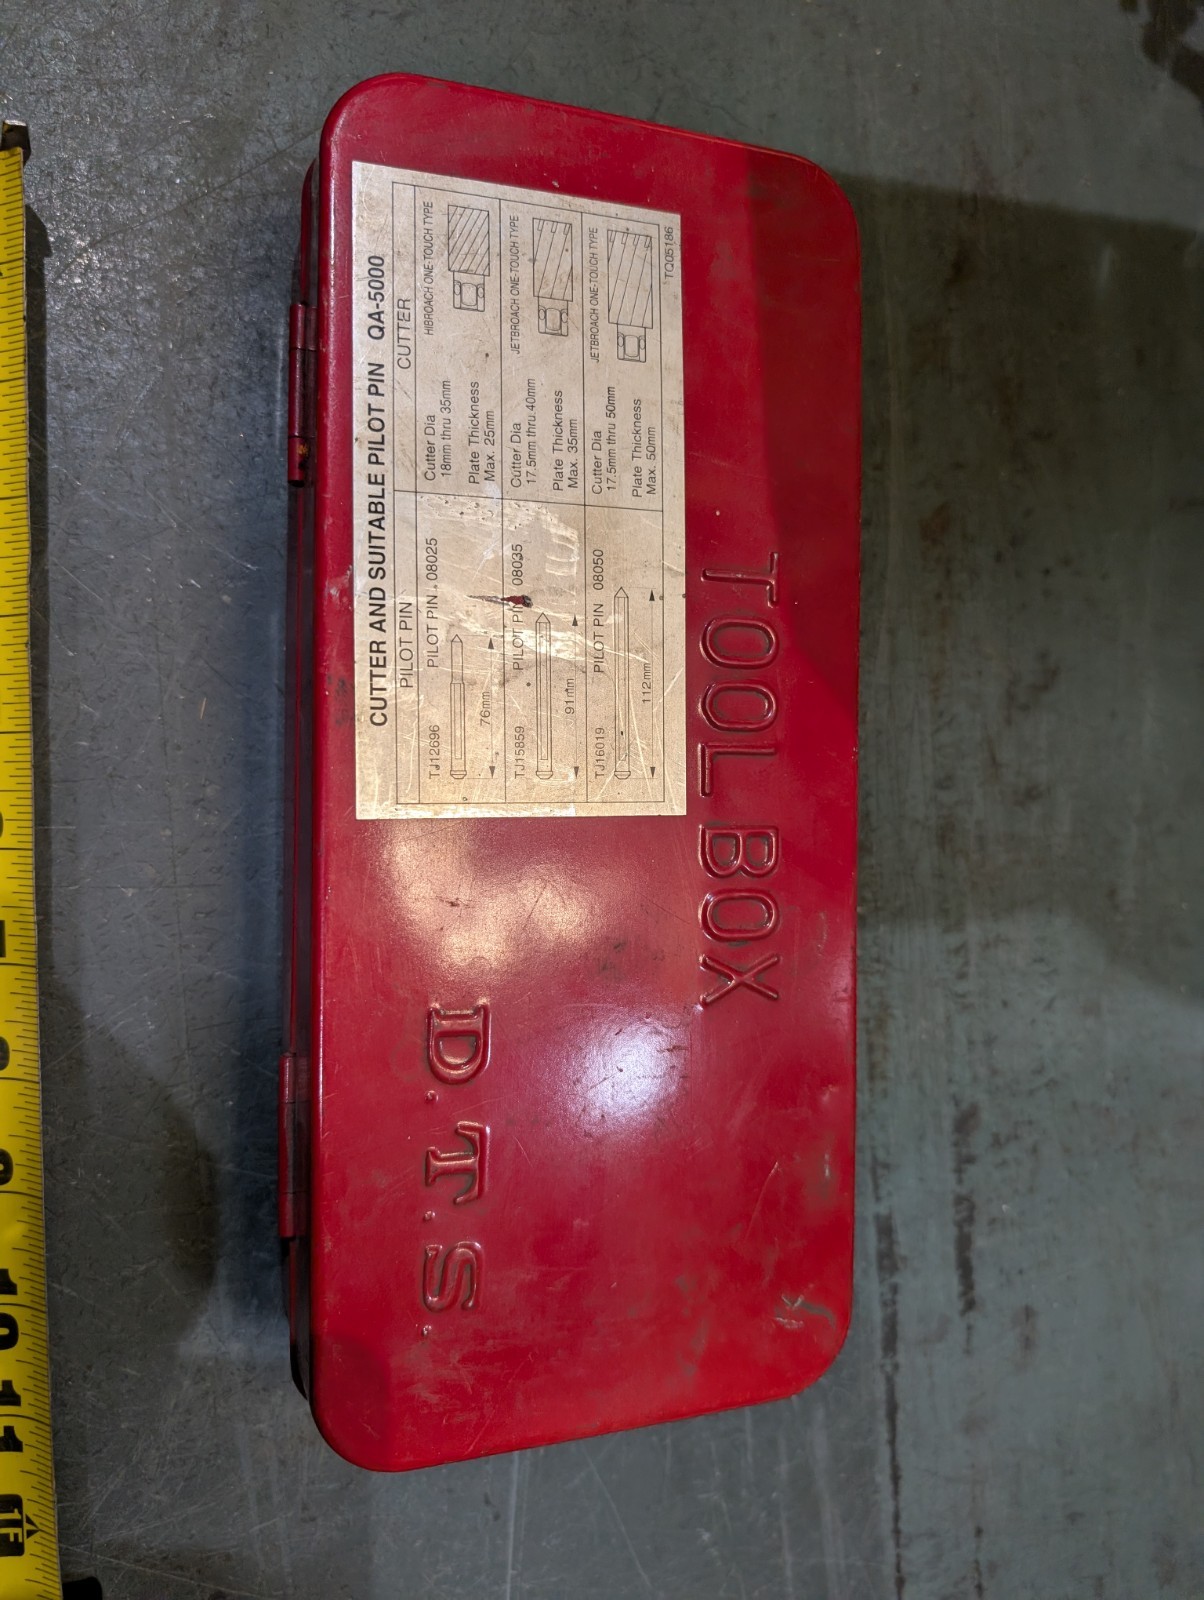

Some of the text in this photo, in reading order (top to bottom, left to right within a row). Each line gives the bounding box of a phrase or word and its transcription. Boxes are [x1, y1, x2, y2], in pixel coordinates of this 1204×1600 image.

[423, 201, 434, 335] HIBROACH ONE-TOUCH TYPE
[509, 215, 520, 354] JETBROACH ONE-TOUCH TYPE
[664, 226, 675, 279] TQ05186
[589, 227, 600, 363] JETBROACH ONE-TOUCH TYPE
[397, 298, 411, 370] CUTTER
[424, 415, 436, 481] Cutter Dia
[441, 380, 451, 477] 18mm thru 35mm
[468, 381, 480, 484] Plate Thickness
[484, 410, 495, 482] Max. 25mm
[511, 423, 522, 488] Cutter Dia
[526, 378, 537, 484] 17.5mm thru 40mm
[552, 390, 564, 491] Plate Thickness
[568, 419, 578, 488] Max. 35mm
[592, 431, 603, 495] Cutter Dia
[605, 386, 617, 491] 17.5mm thru 50mm
[631, 399, 643, 498] Plate Thickness
[646, 426, 656, 495] Max. 50mm
[368, 255, 387, 726] CUTTER AND SUITABLE PILOT PIN QA-5000
[512, 544, 523, 586] 08035
[426, 538, 439, 668] PILOT PIN 08025
[593, 549, 604, 673] PILOT PIN 08050
[399, 602, 414, 688] PILOT PIN
[513, 630, 524, 671] PILOT
[480, 691, 491, 726] 76mm
[564, 679, 575, 714] 91mm
[642, 663, 651, 704] 112mm
[428, 725, 441, 779] TJ12696
[514, 726, 525, 779] TJ15859
[594, 727, 605, 779] TJ16019
[698, 553, 780, 1007] TOOL BOX
